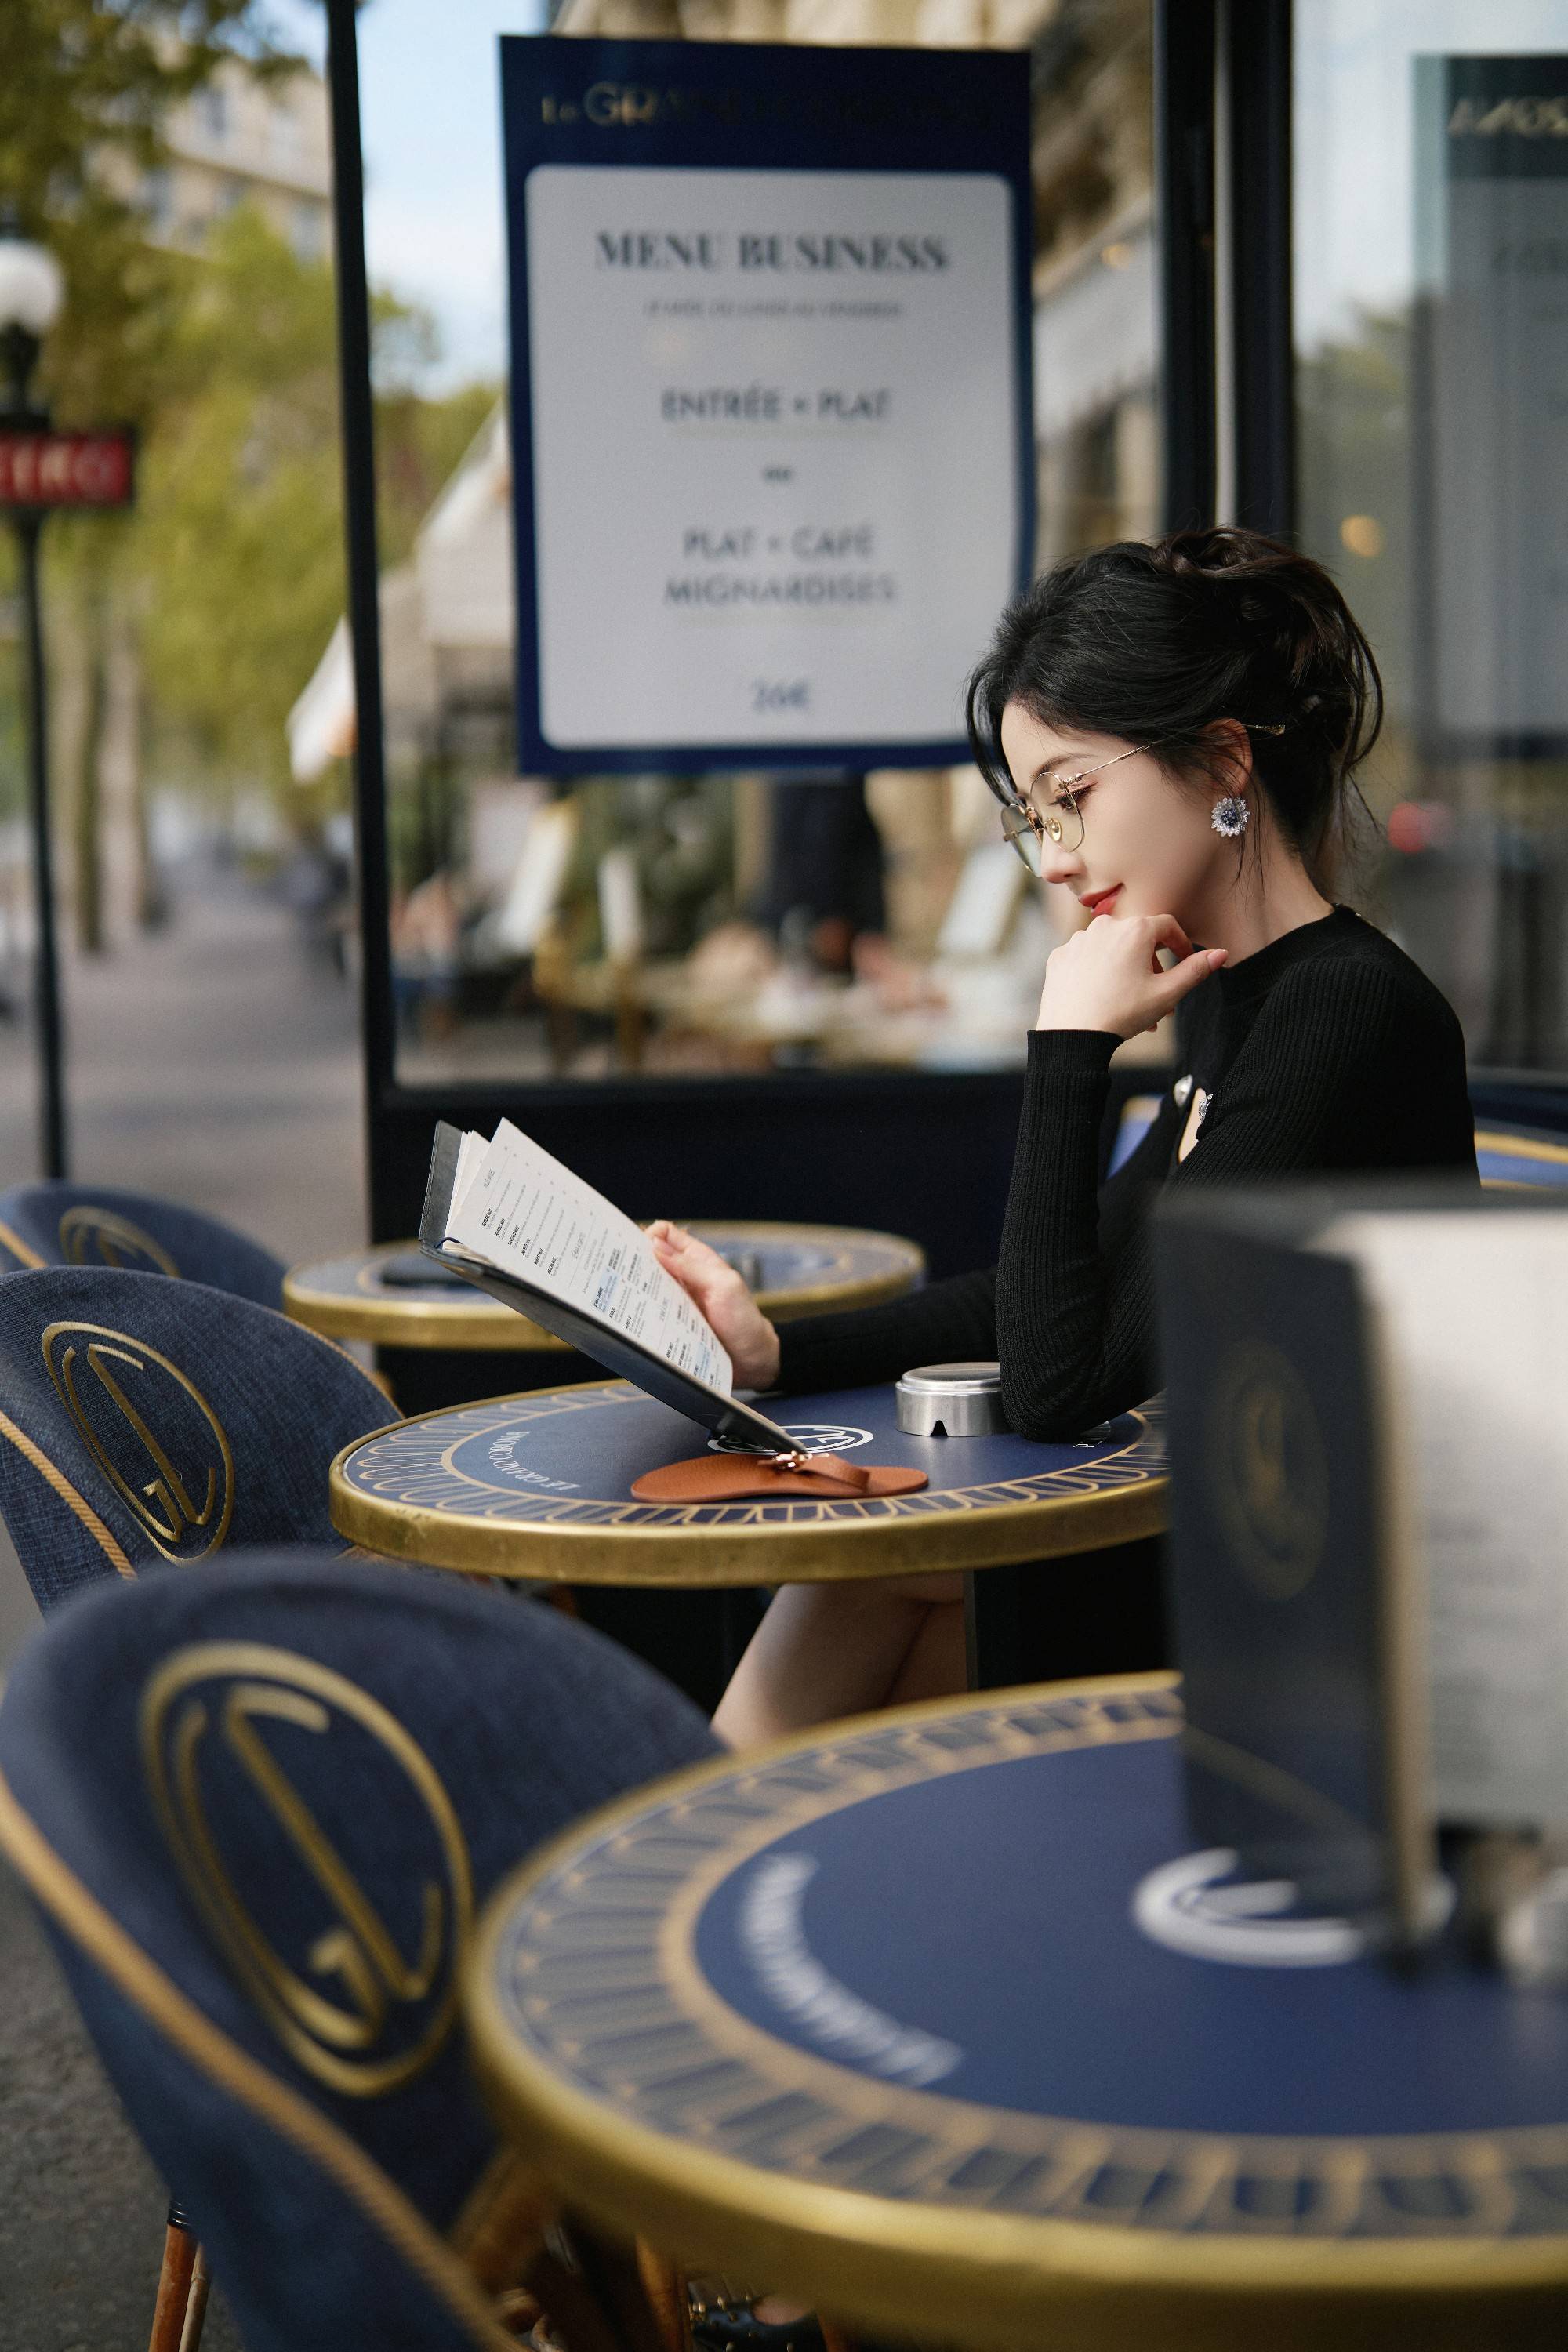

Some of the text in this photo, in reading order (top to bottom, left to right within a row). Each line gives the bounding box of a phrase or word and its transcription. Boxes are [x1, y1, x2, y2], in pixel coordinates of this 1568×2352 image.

[594, 232, 949, 273] MENU BUSINESS
[662, 382, 780, 421] ENTRÉE
[818, 388, 892, 420] PLAT
[683, 528, 754, 559] PLAT
[790, 523, 873, 561] CAFÉ
[665, 573, 895, 606] MIGNARDISES
